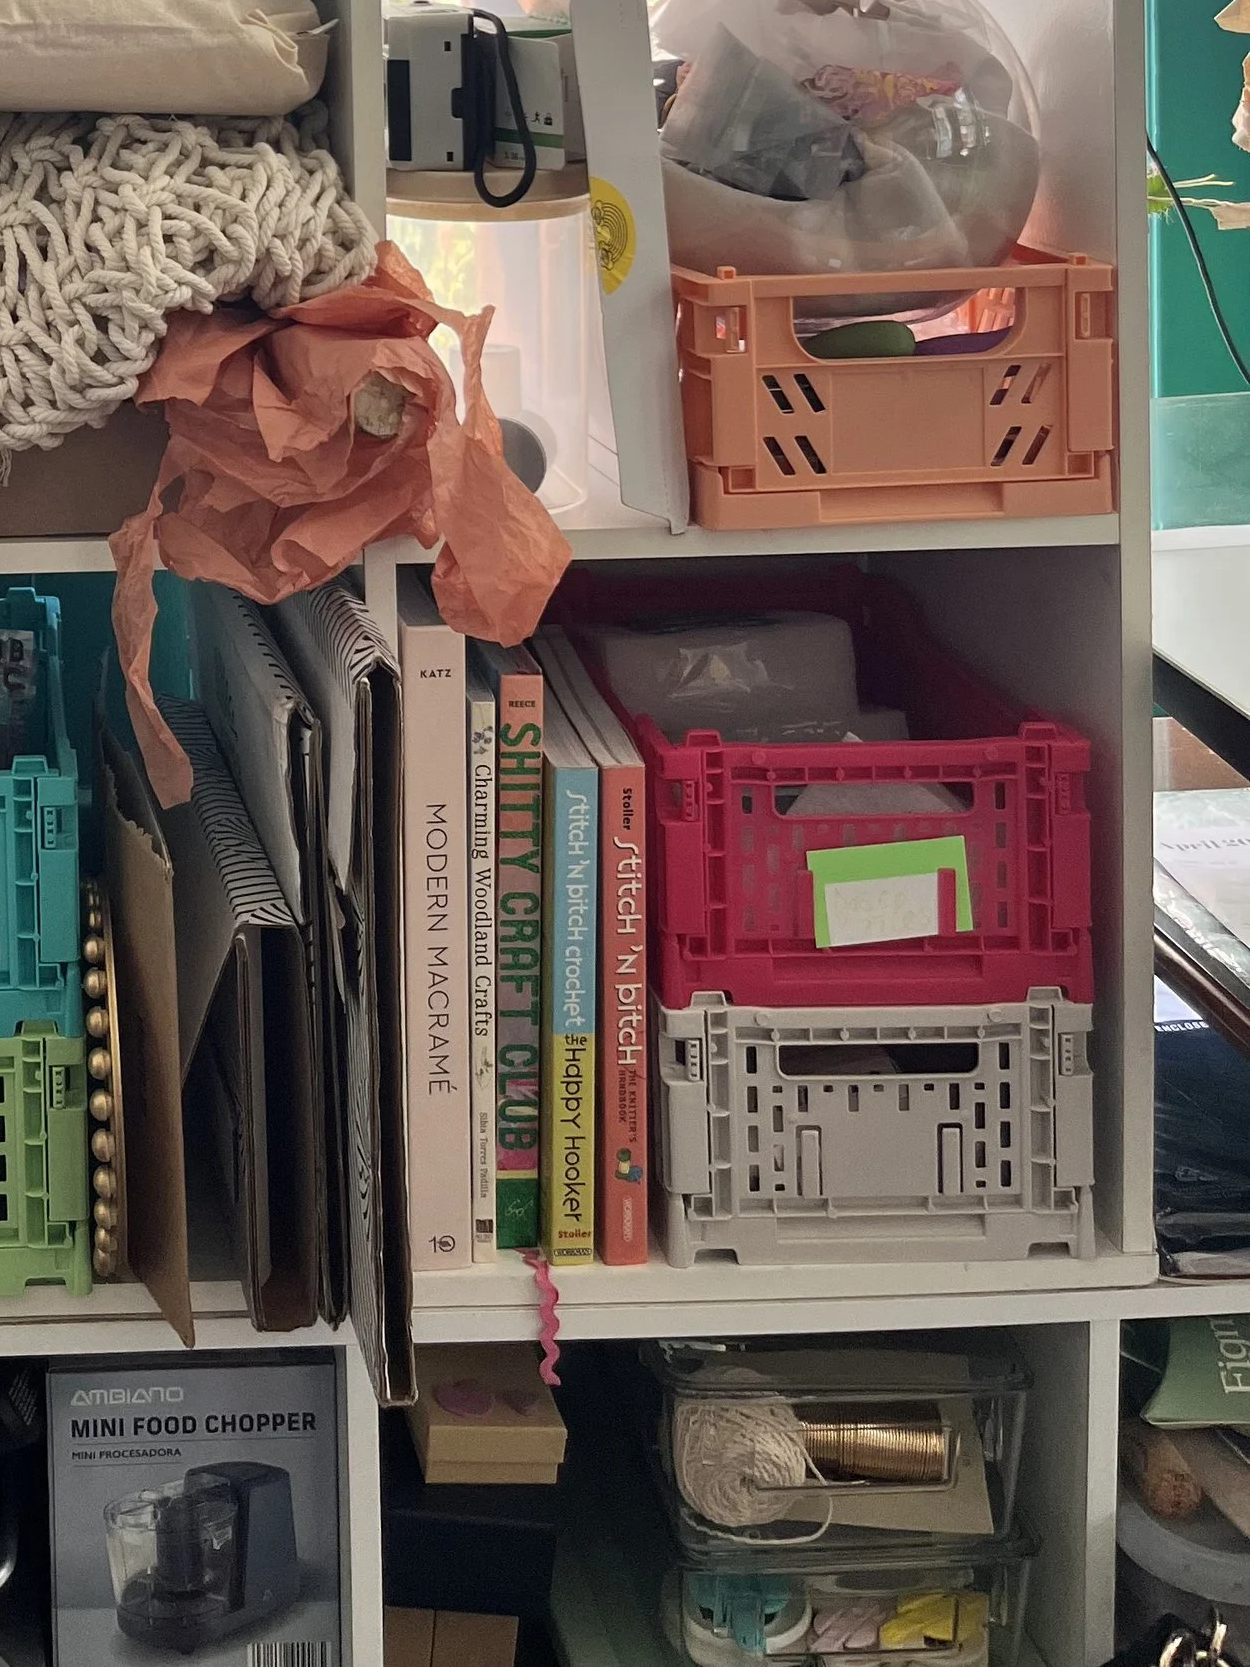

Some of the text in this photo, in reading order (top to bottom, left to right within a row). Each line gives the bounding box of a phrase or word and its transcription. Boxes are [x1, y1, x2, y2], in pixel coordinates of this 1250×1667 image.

[420, 669, 452, 678] KATZ
[508, 700, 537, 708] REECE
[622, 788, 633, 831] Stoller
[472, 764, 494, 1038] Charming Woodland Crafts
[425, 804, 457, 1094] MODERN MACRAMÉ
[497, 723, 542, 1150] SHITTY CRAFT CLUB
[628, 1069, 637, 1086] THE
[479, 1137, 488, 1165] Torres
[479, 1168, 488, 1199] Padilla
[558, 1229, 592, 1238] Stoller
[70, 1386, 184, 1407] AMBIANO
[71, 1412, 317, 1438] MINI FOOD CHOPPER
[72, 1447, 182, 1461] MINI PROCESADORA
